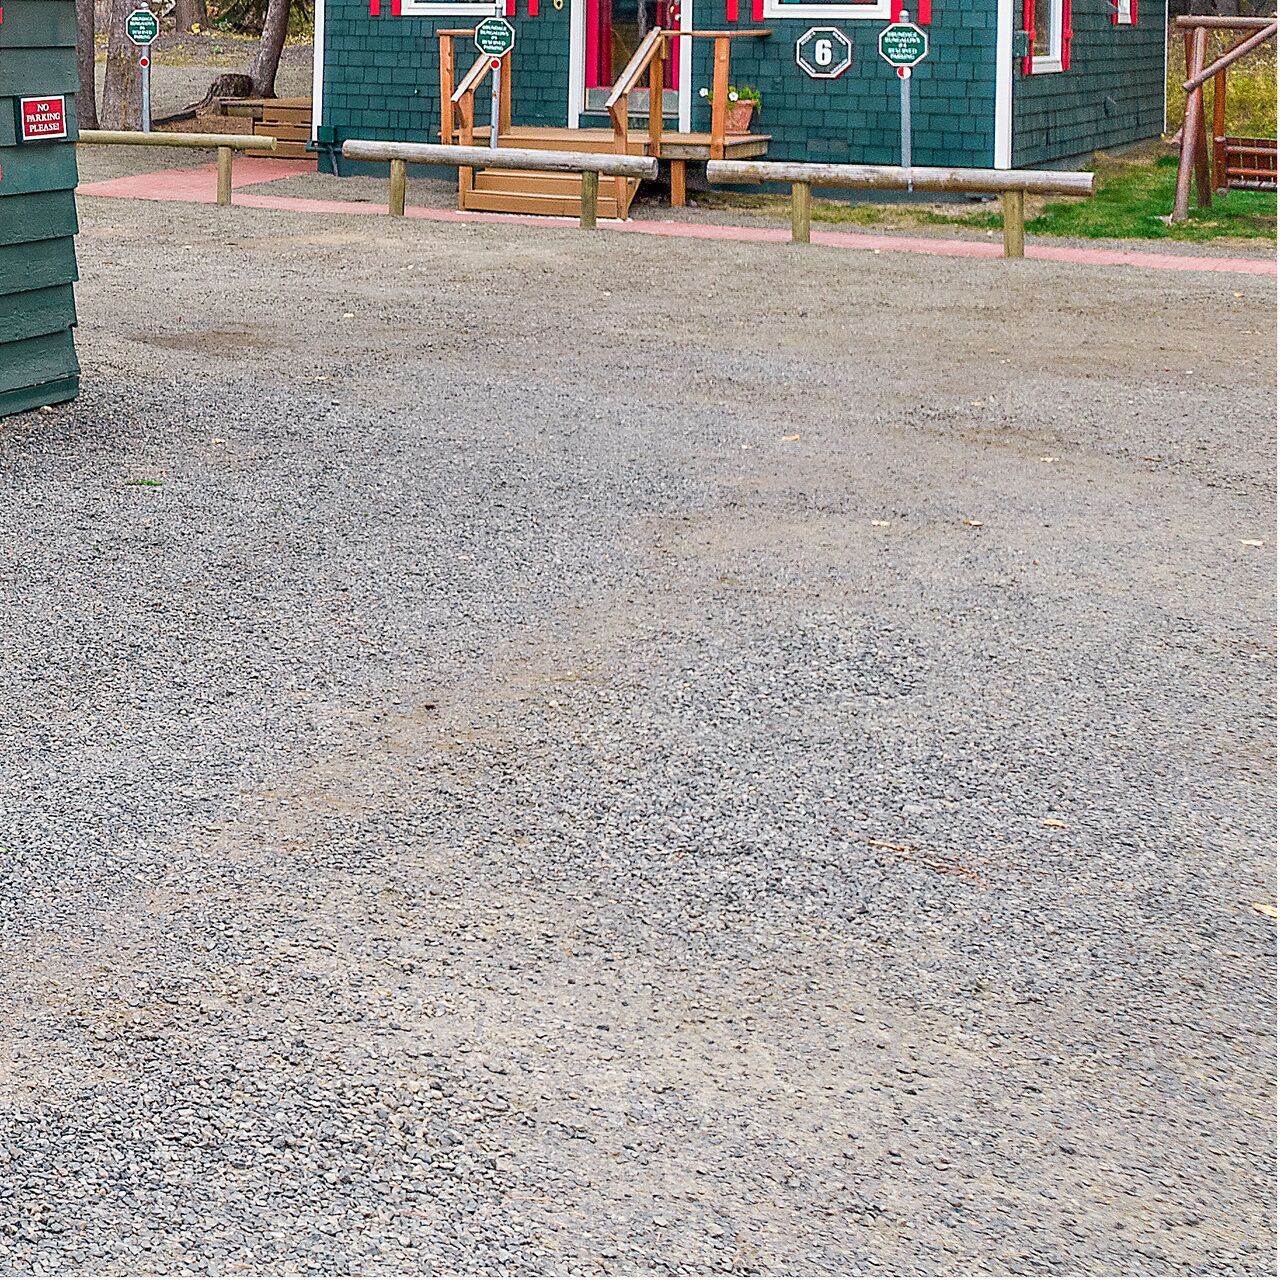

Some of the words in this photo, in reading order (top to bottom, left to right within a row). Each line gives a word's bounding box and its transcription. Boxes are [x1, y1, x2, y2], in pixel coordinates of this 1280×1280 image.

[815, 39, 832, 66] 6
[37, 103, 50, 112] NO
[26, 112, 61, 122] PARKING
[29, 123, 60, 132] PLEASE!
